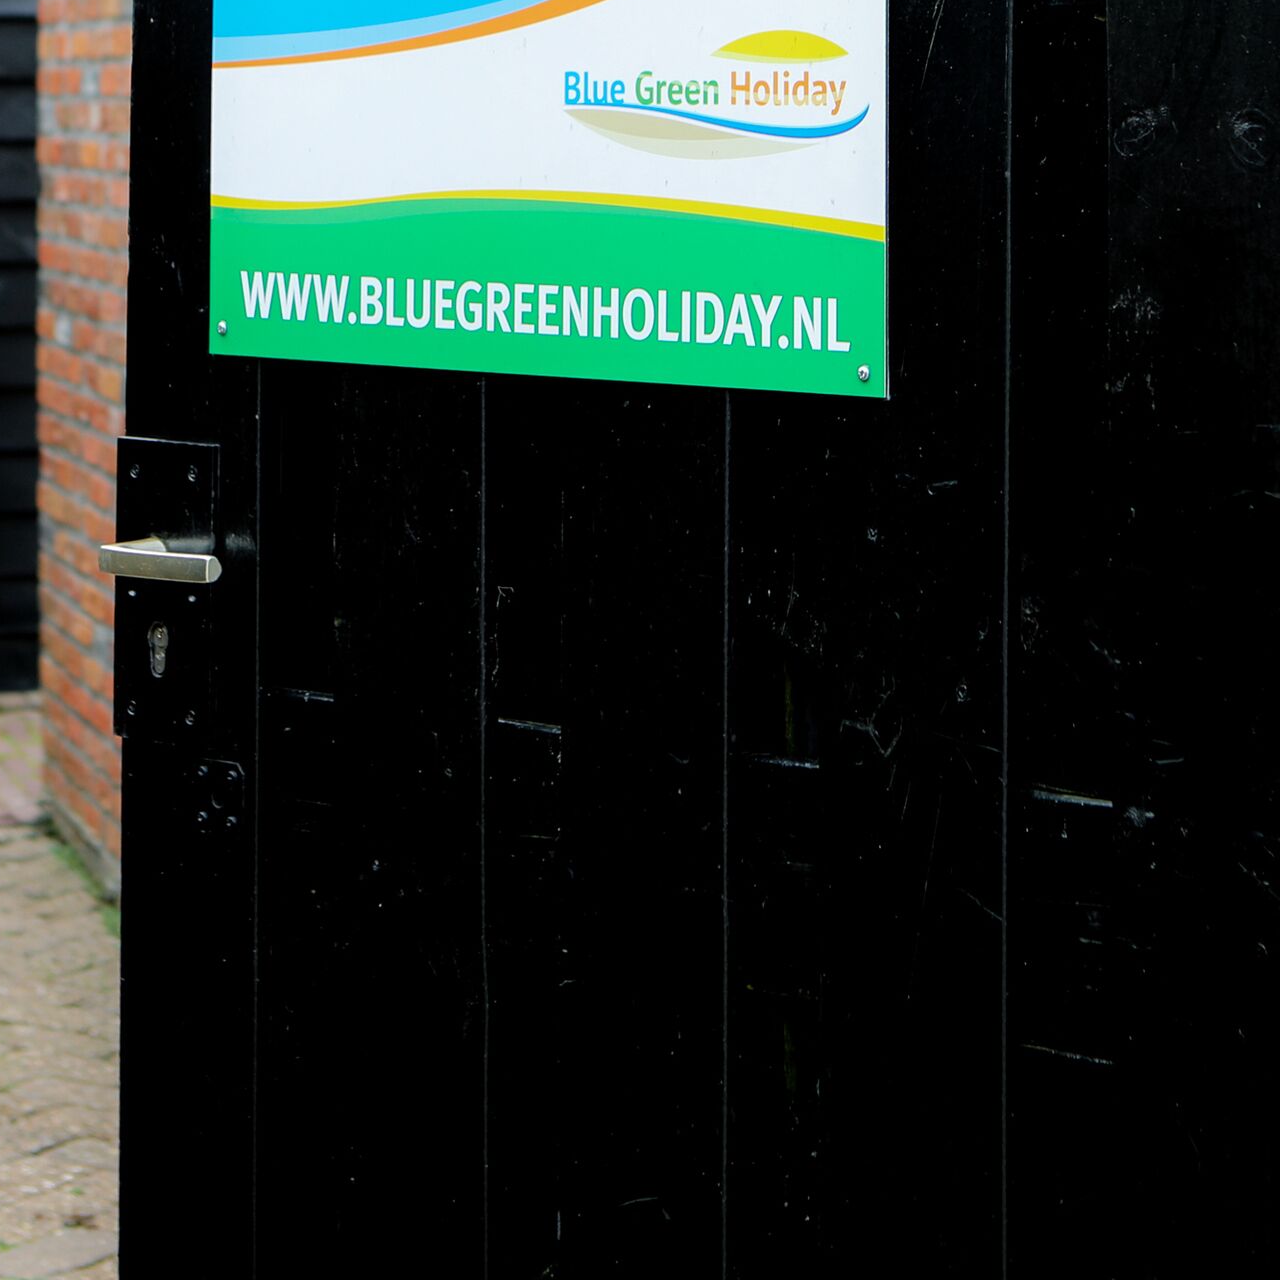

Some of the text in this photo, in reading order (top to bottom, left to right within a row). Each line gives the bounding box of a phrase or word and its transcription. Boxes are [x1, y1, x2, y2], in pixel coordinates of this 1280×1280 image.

[564, 70, 847, 116] Blue Green Holiday
[239, 270, 852, 353] WWW.BLUEGREENHOLIDAY.NL
